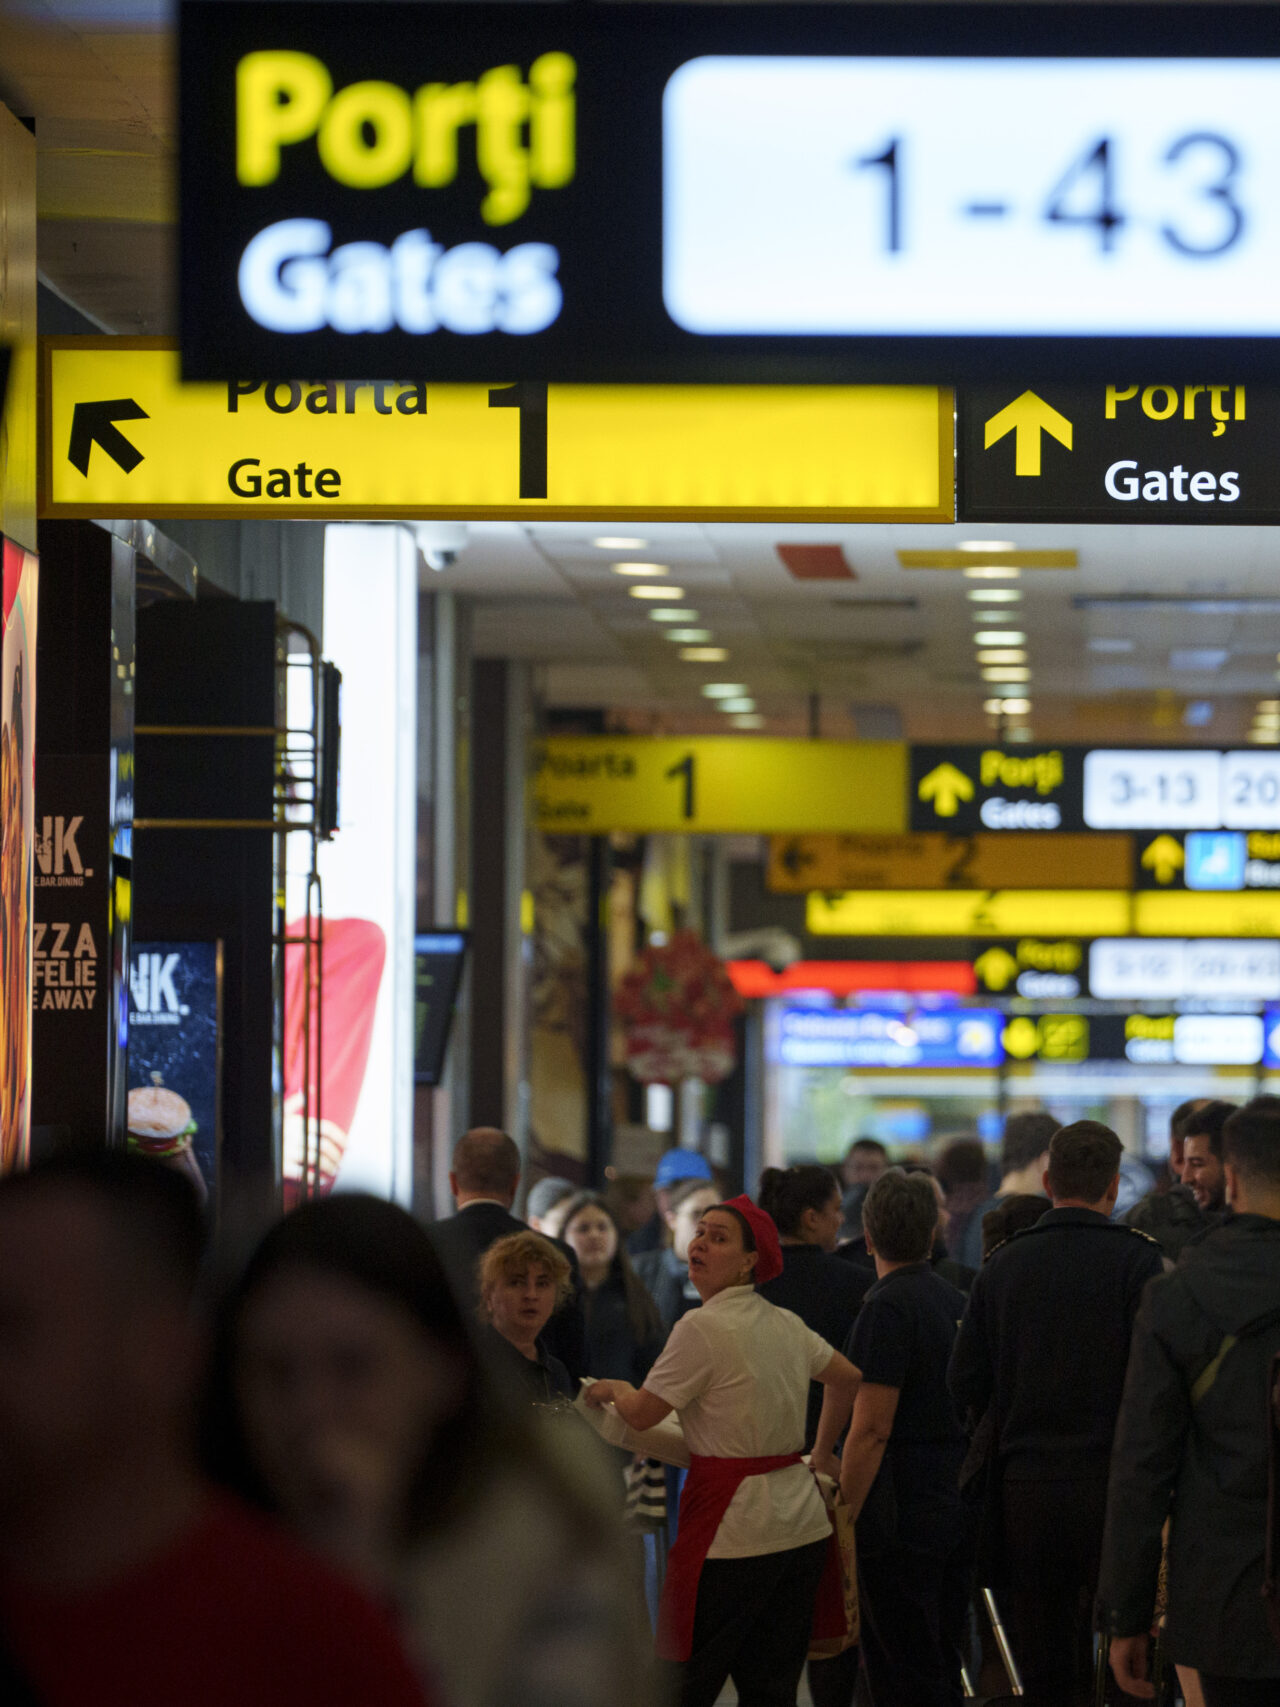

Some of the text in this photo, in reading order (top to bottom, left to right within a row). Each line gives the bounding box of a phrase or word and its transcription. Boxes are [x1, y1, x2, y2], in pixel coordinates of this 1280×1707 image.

[848, 130, 1249, 262] 1-43
[238, 217, 563, 335] Gates
[227, 380, 548, 499] Poarta 1
[227, 458, 342, 498] Gate
[1104, 460, 1241, 502] Gates
[667, 754, 697, 820] 1
[42, 989, 97, 1010] AWAY
